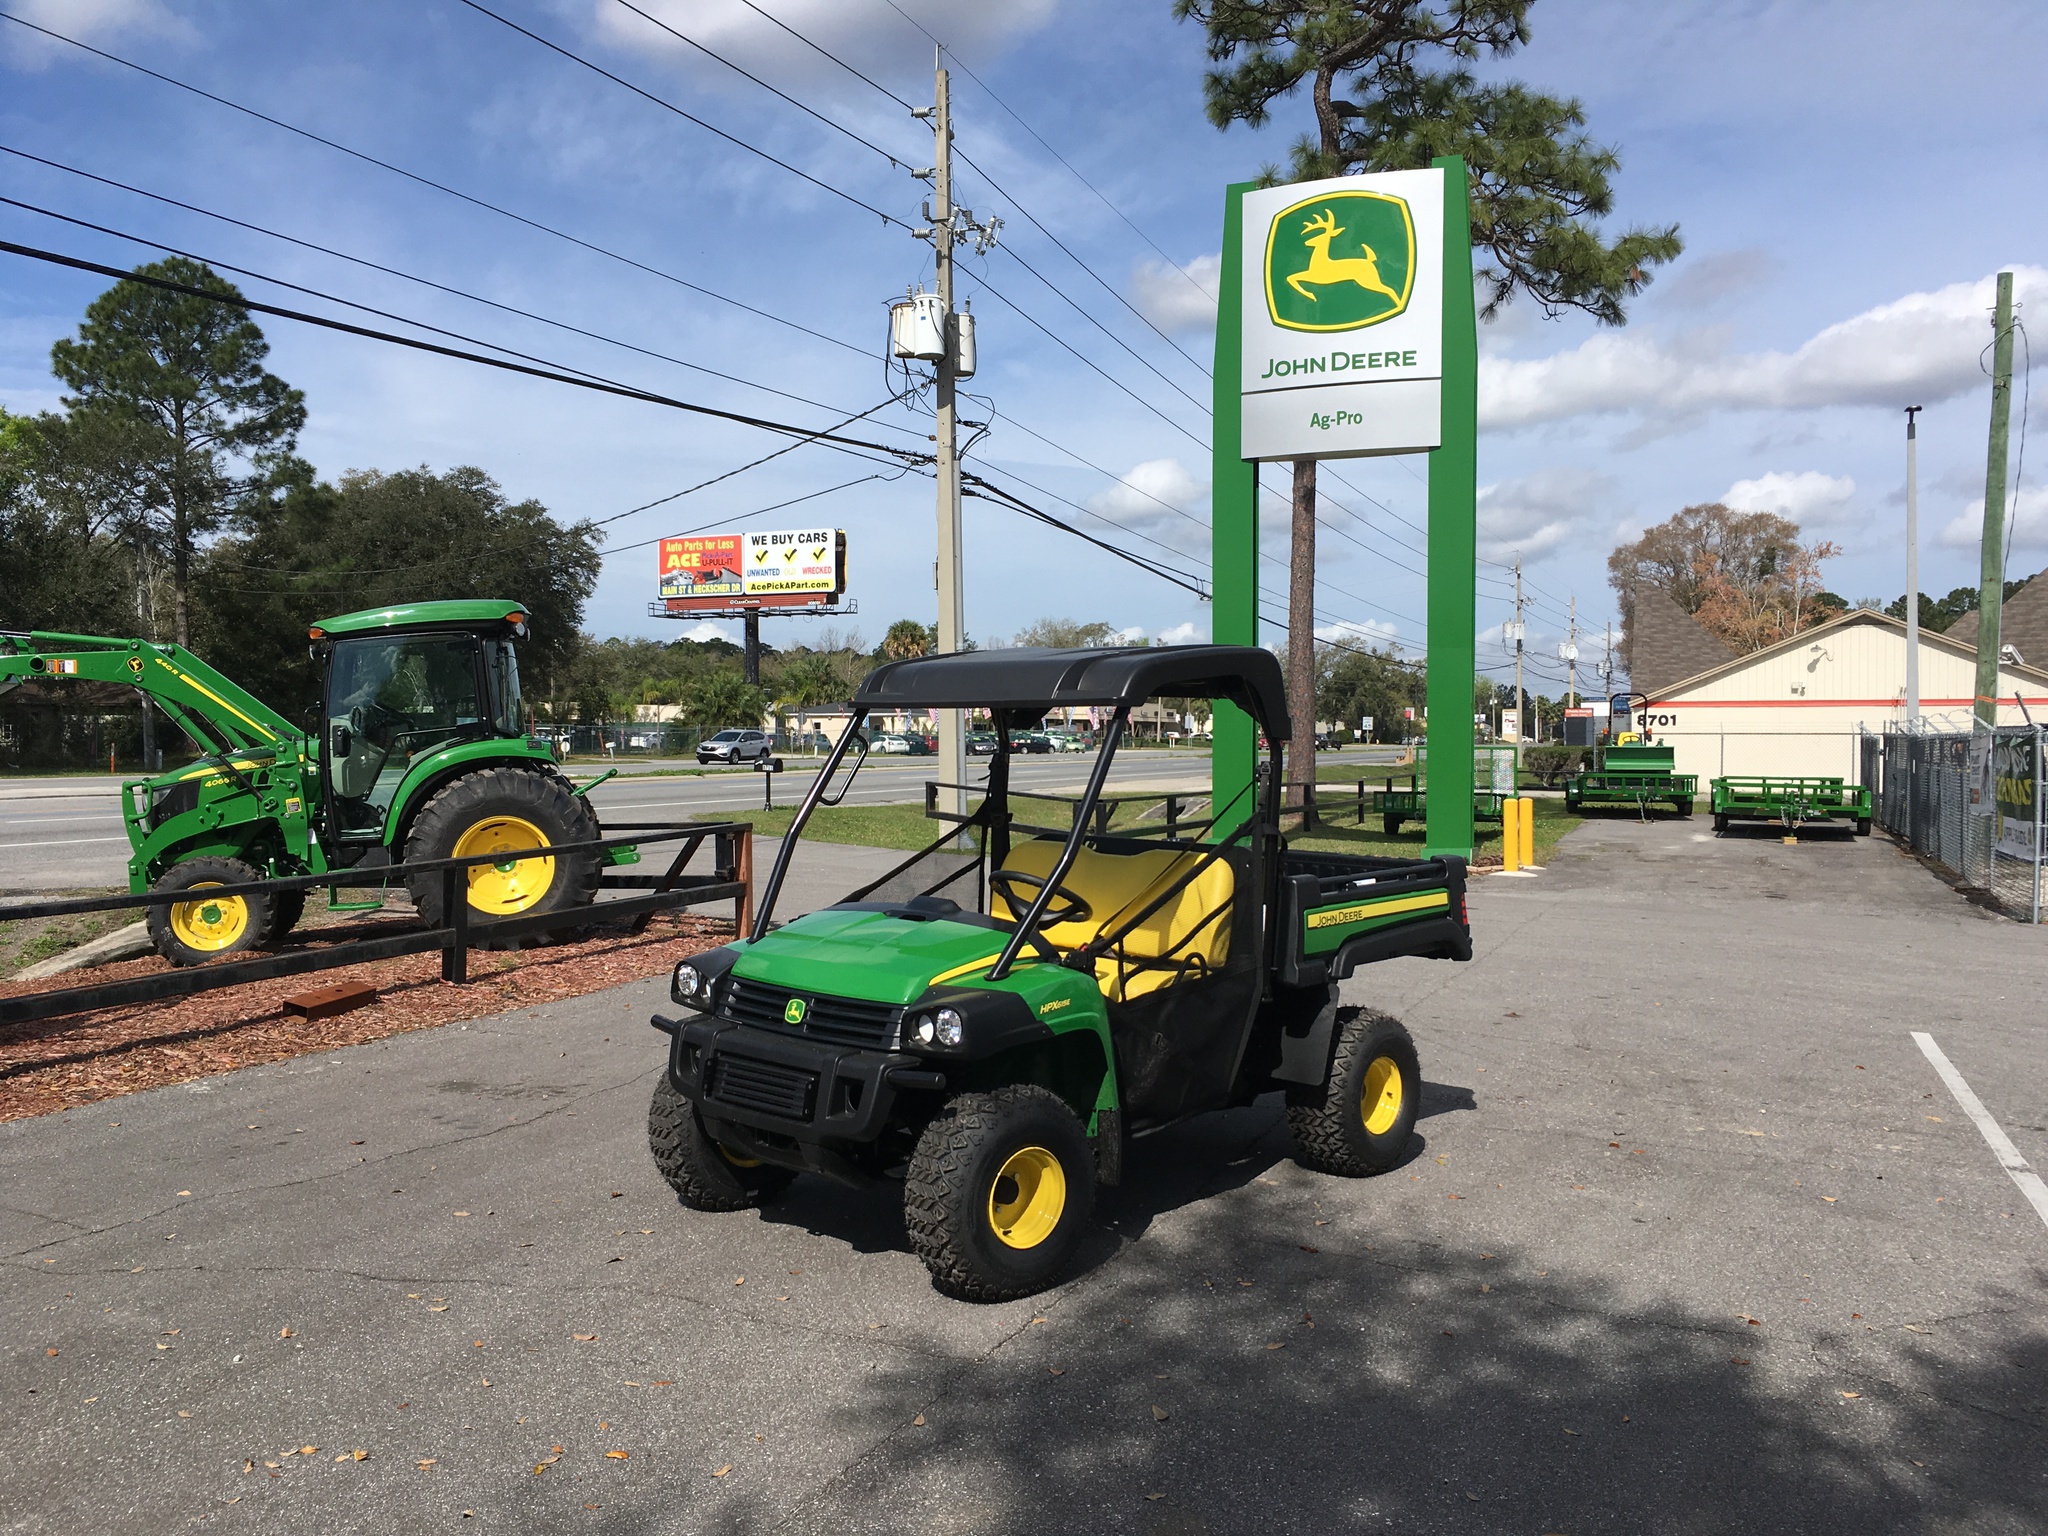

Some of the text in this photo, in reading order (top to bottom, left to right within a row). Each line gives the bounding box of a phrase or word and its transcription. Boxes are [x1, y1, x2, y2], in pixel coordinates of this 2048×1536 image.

[1261, 350, 1418, 379] JOHN DEERE
[1310, 410, 1363, 430] Ag-Pro
[666, 539, 734, 552] Auto Parts for Less
[751, 532, 828, 546] WE BUY CARS
[667, 553, 701, 568] ACE
[702, 558, 733, 567] U-PULL-IT
[747, 566, 832, 577] UNWANTED OLD WRECKED
[662, 583, 741, 595] MAIN ST & HECKSCHER DR
[751, 582, 829, 591] AcePickAPart.com
[1637, 714, 1677, 726] 8701
[1317, 910, 1363, 927] JOHN DEERE
